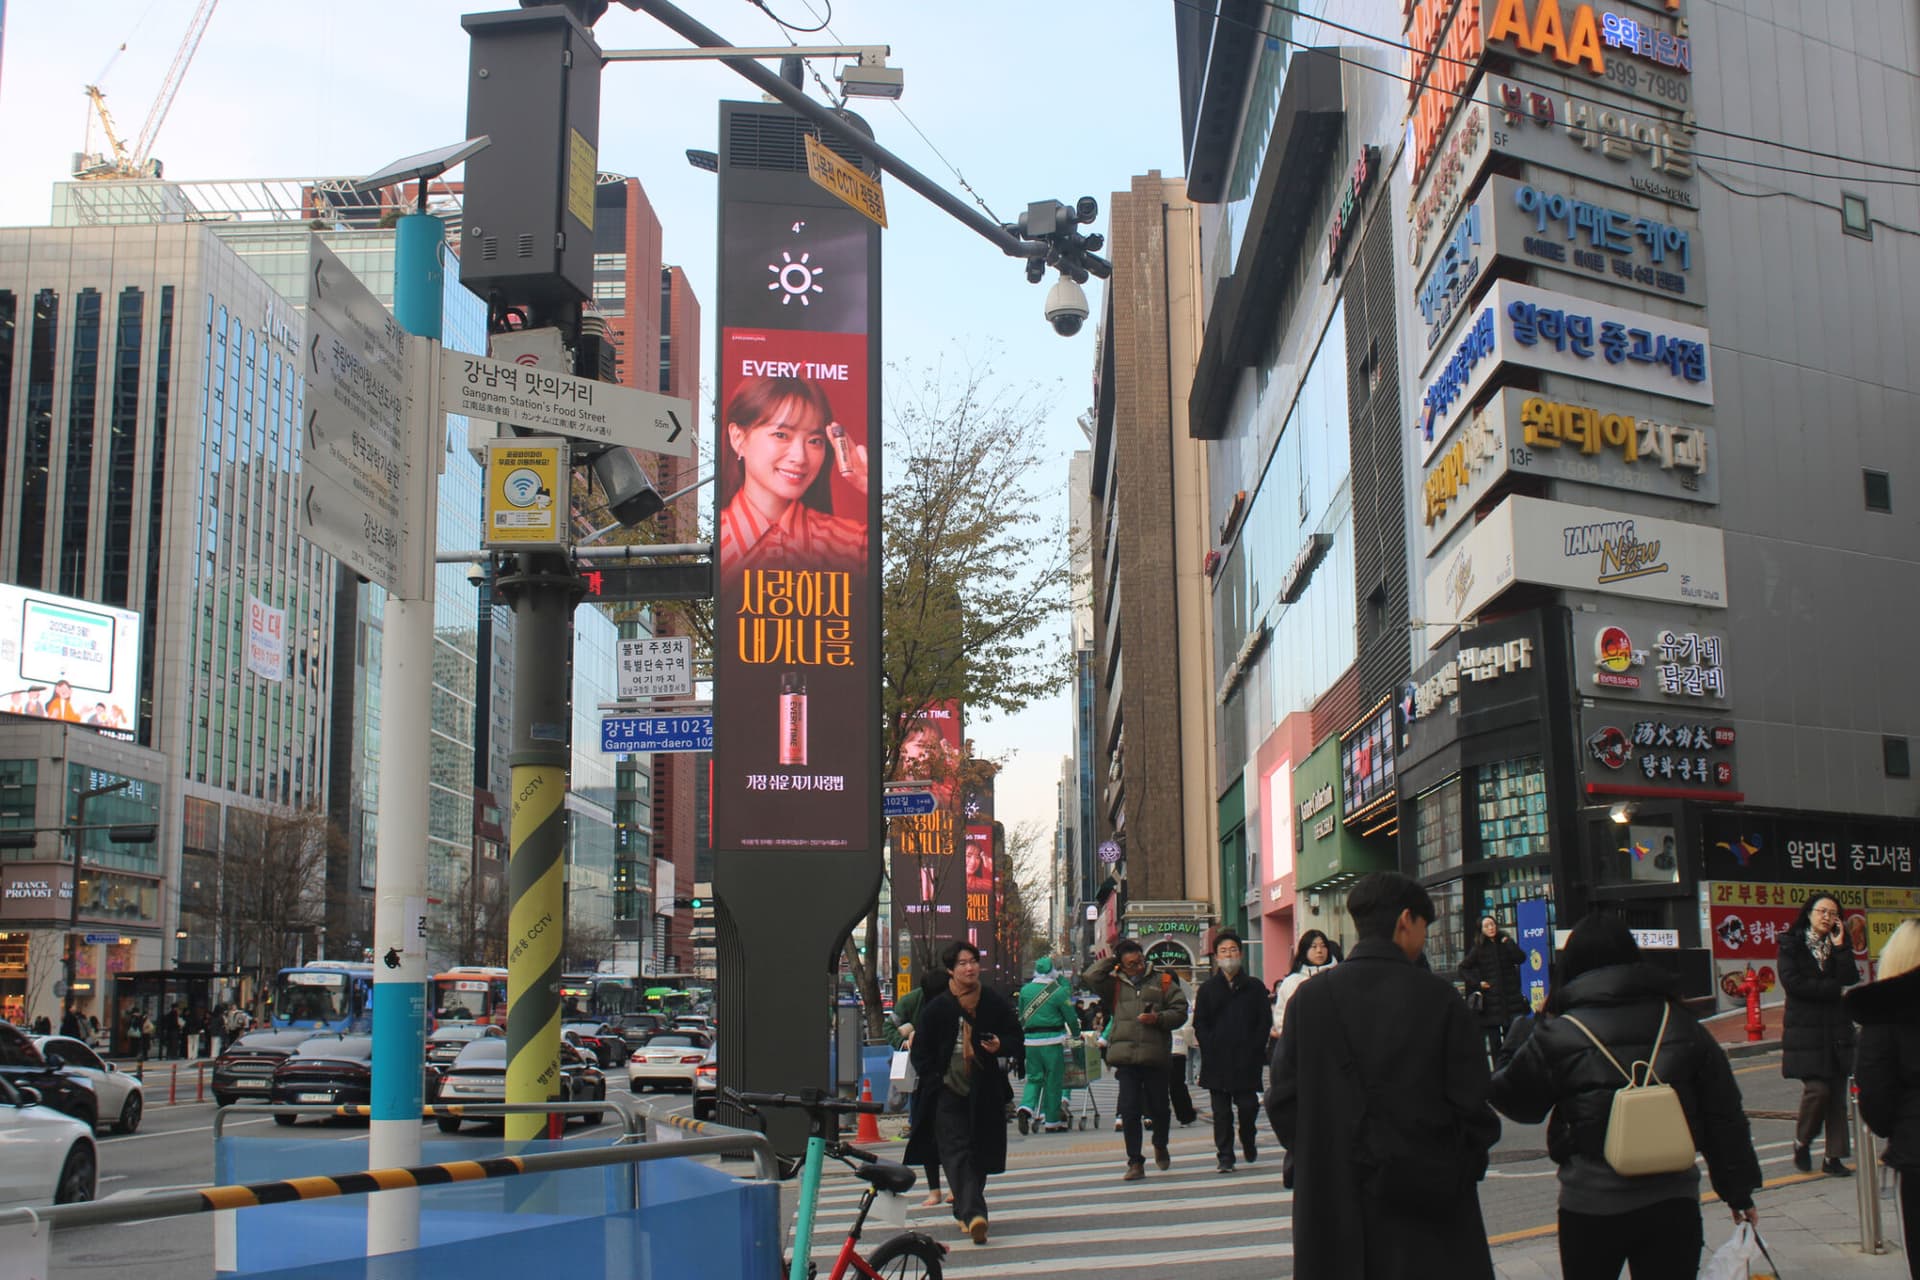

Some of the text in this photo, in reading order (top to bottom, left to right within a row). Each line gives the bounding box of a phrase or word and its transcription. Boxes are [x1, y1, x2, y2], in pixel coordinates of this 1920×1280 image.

[1488, 0, 1606, 75] AAA
[1602, 11, 1692, 73] 유학라운지
[1494, 131, 1509, 145] 5F
[837, 168, 858, 201] CCTV
[1515, 186, 1690, 271] 아이패드케어
[1508, 301, 1594, 358] 알라딘
[1599, 321, 1706, 383] 중고서점
[464, 360, 593, 405] 강남역 맛의거리
[742, 359, 849, 381] EVERY TIME
[462, 386, 606, 423] Gangnam Station's Food Street
[1520, 397, 1708, 474] 원데이치과
[1510, 447, 1533, 467] 13F
[1564, 520, 1634, 556] TANNING
[1600, 535, 1660, 574] Now
[737, 568, 853, 617] 사랑하자
[252, 604, 282, 640] 임대
[622, 641, 683, 656] 불법 주정차
[1657, 631, 1721, 666] 유가네
[624, 658, 685, 673] 특별단속구역
[632, 675, 676, 684] 여기까지
[1660, 664, 1726, 698] 닭갈비
[930, 710, 951, 718] TIME
[605, 739, 693, 750] Gangnam-daero
[1642, 754, 1709, 782] 탕화쿵푸
[520, 776, 544, 801] CCTV
[746, 774, 844, 791] 가장 쉬운 자기 사랑법
[1787, 841, 1911, 872] 알라딘 중고서점
[5, 889, 52, 898] PROVOST
[12, 881, 48, 889] FRANCK
[1718, 885, 1733, 901] 2F
[1738, 884, 1785, 905] 부동산
[1791, 888, 1805, 903] 02
[527, 914, 552, 940] CCTV
[1139, 924, 1155, 936] NA
[1523, 928, 1544, 938] K-POP
[1642, 932, 1673, 946] 중고서점
